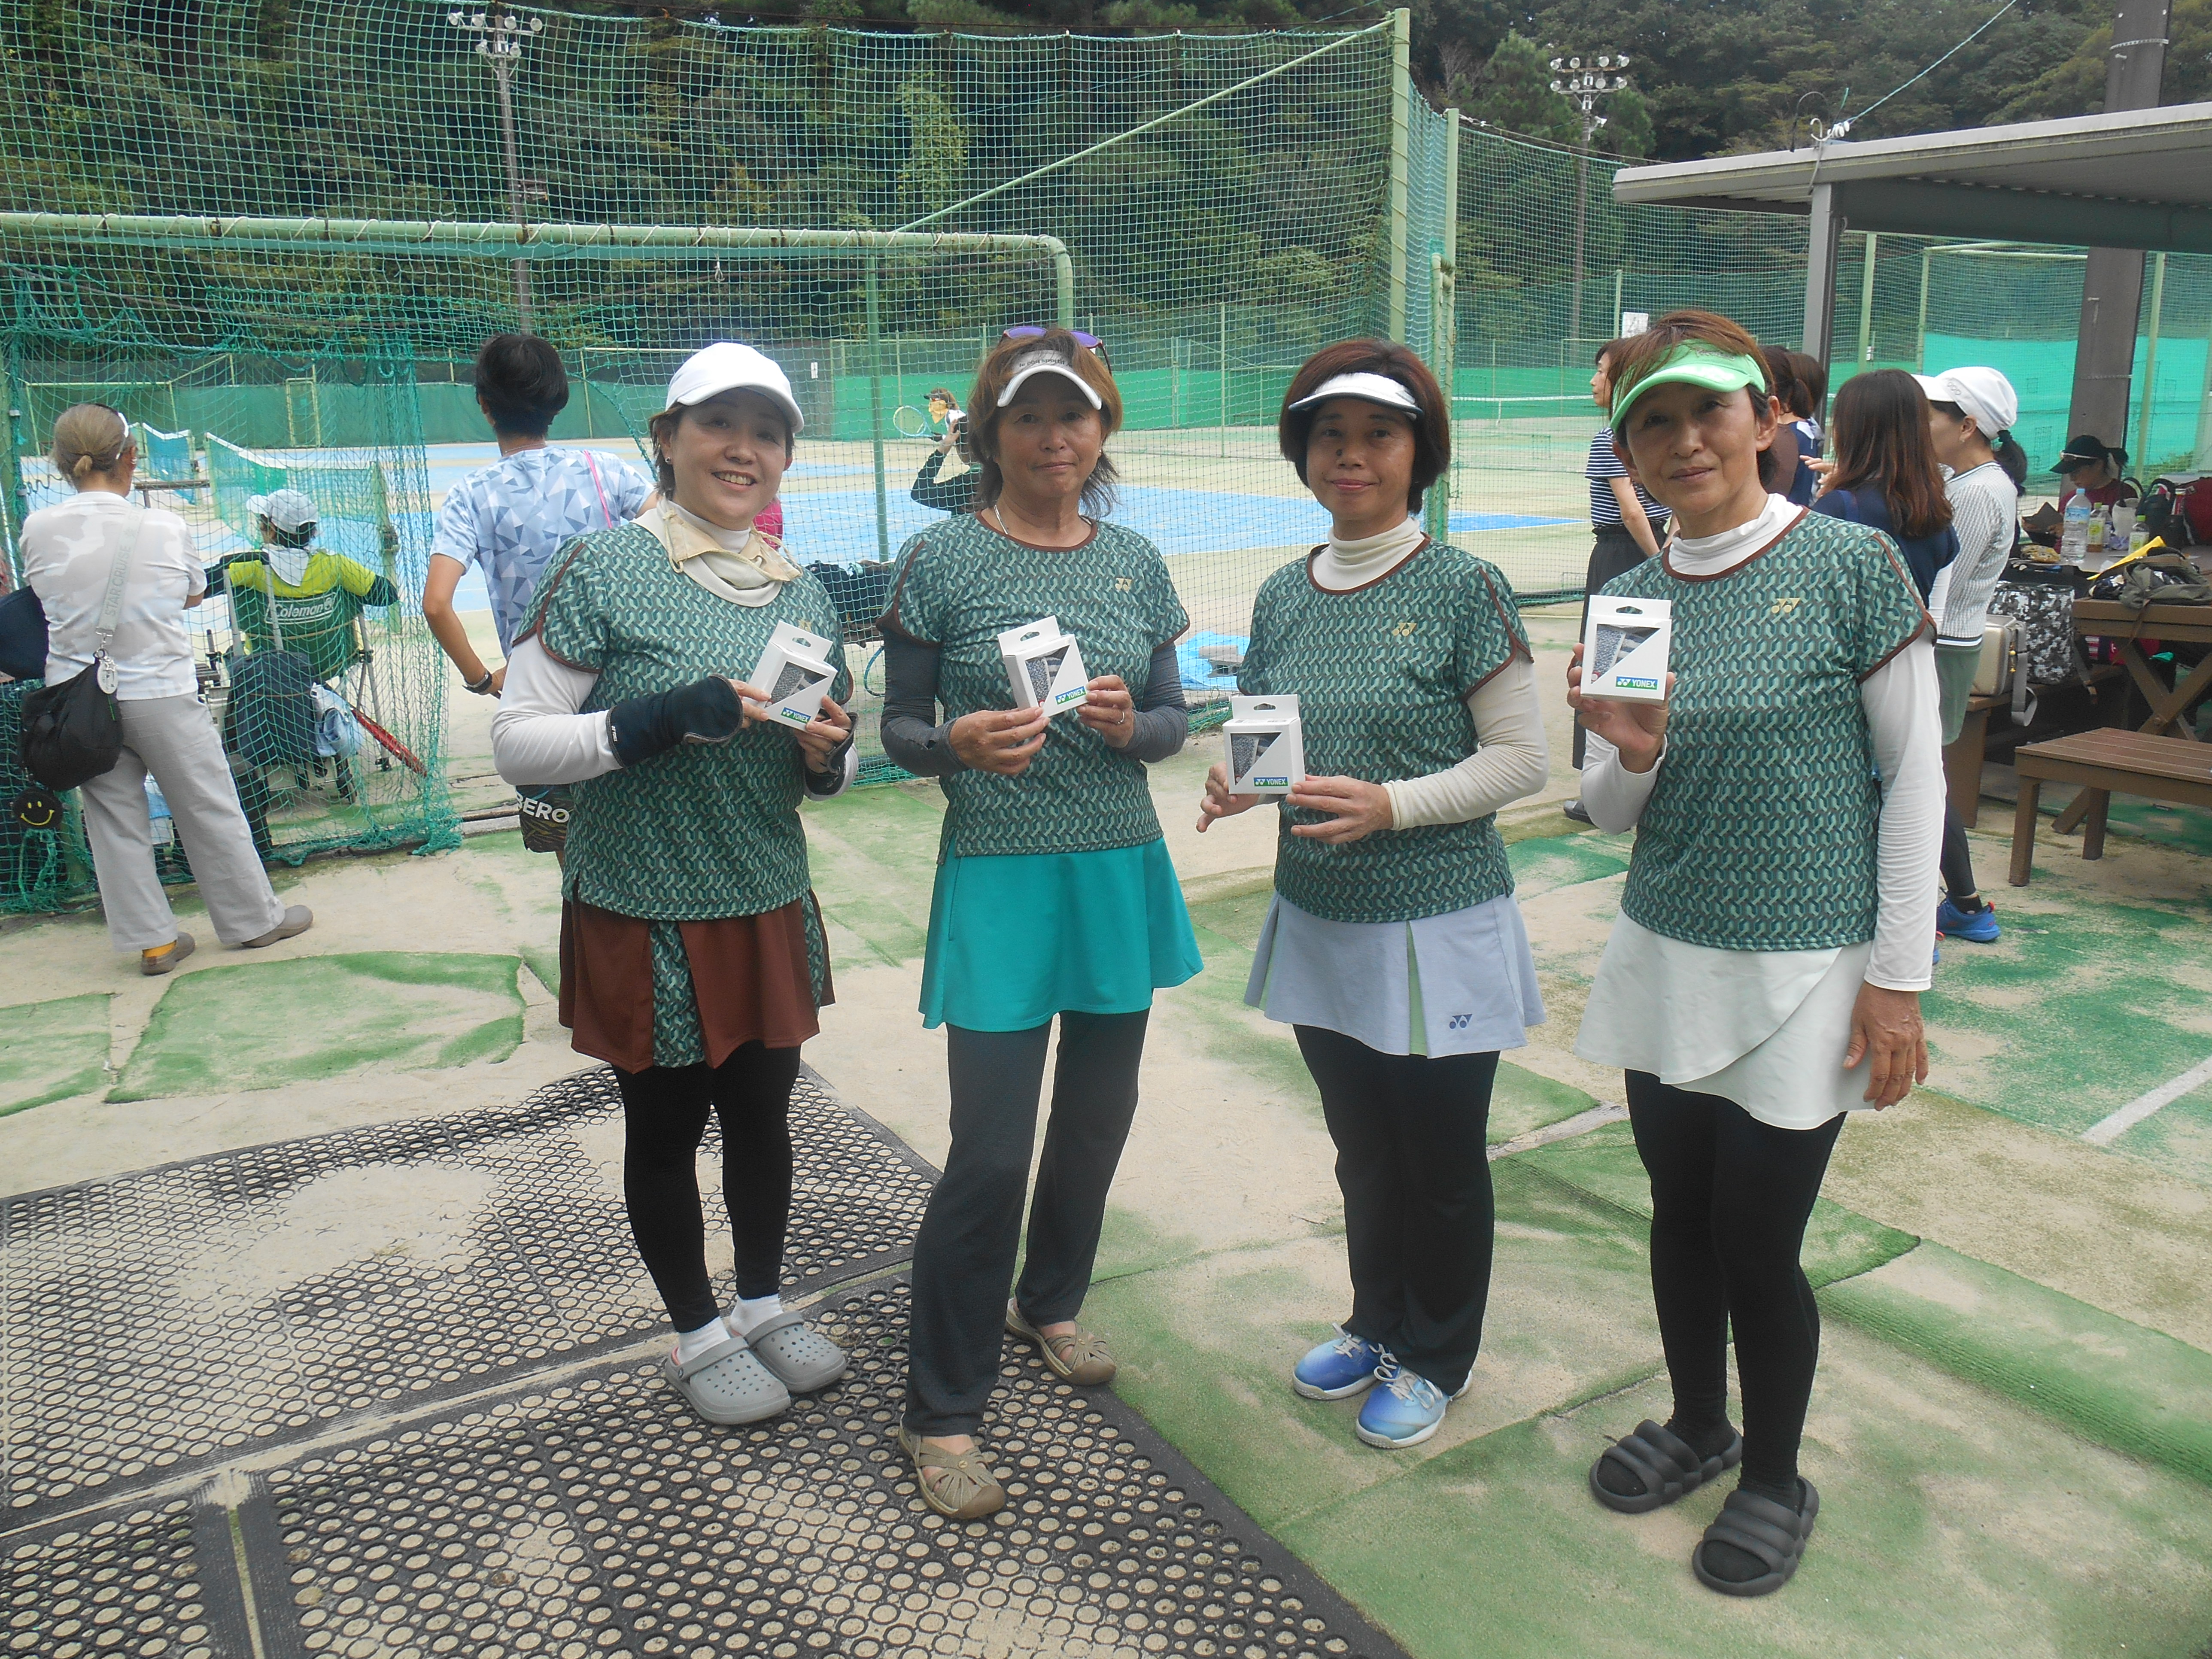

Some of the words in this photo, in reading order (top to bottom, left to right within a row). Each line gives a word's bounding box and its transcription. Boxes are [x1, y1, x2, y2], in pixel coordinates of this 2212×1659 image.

[105, 590, 122, 617] STAR
[274, 603, 324, 618] Coleman
[1632, 679, 1656, 688] YONEX
[1066, 688, 1085, 699] YONEX
[793, 711, 810, 723] YONEX
